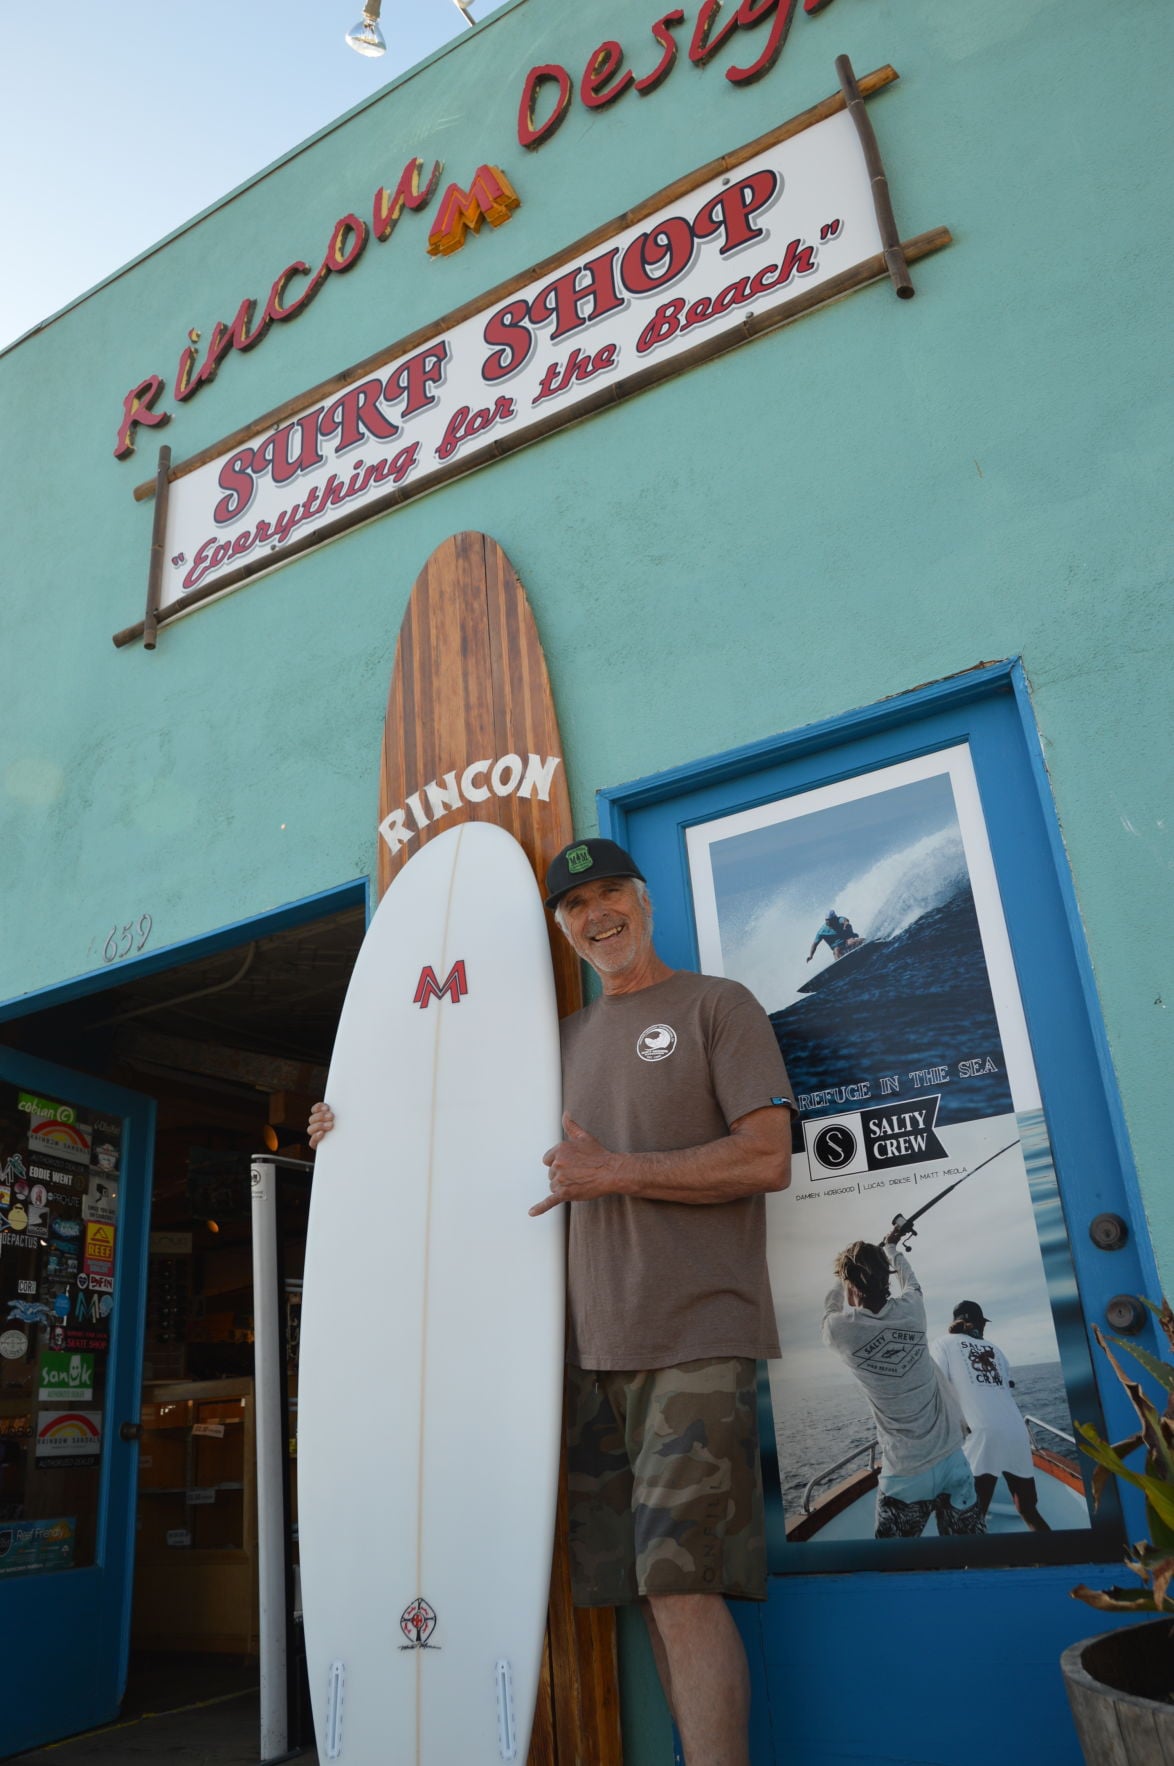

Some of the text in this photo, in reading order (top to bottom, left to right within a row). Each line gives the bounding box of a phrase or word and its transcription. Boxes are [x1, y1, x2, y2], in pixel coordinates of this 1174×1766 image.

[113, 0, 836, 460] Rincon Desig
[212, 169, 780, 524] SURF SHOP
[172, 219, 842, 590] "Everything for the Beach"
[378, 754, 561, 856] RINCON
[103, 913, 153, 963] 659
[413, 960, 468, 1009] M
[798, 1057, 998, 1110] REFUGE IN THE SEA
[18, 1098, 54, 1120] cobian
[869, 1110, 927, 1138] SALTY
[873, 1133, 927, 1159] CREW
[29, 1166, 73, 1186] EDDIE WENT
[863, 1181, 885, 1191] LUCAS
[919, 1171, 939, 1181] MATT
[943, 1166, 968, 1177] MEOLA
[88, 1244, 112, 1258] REEF
[864, 1331, 915, 1355] SALTY CREW
[961, 1341, 993, 1353] SALTY
